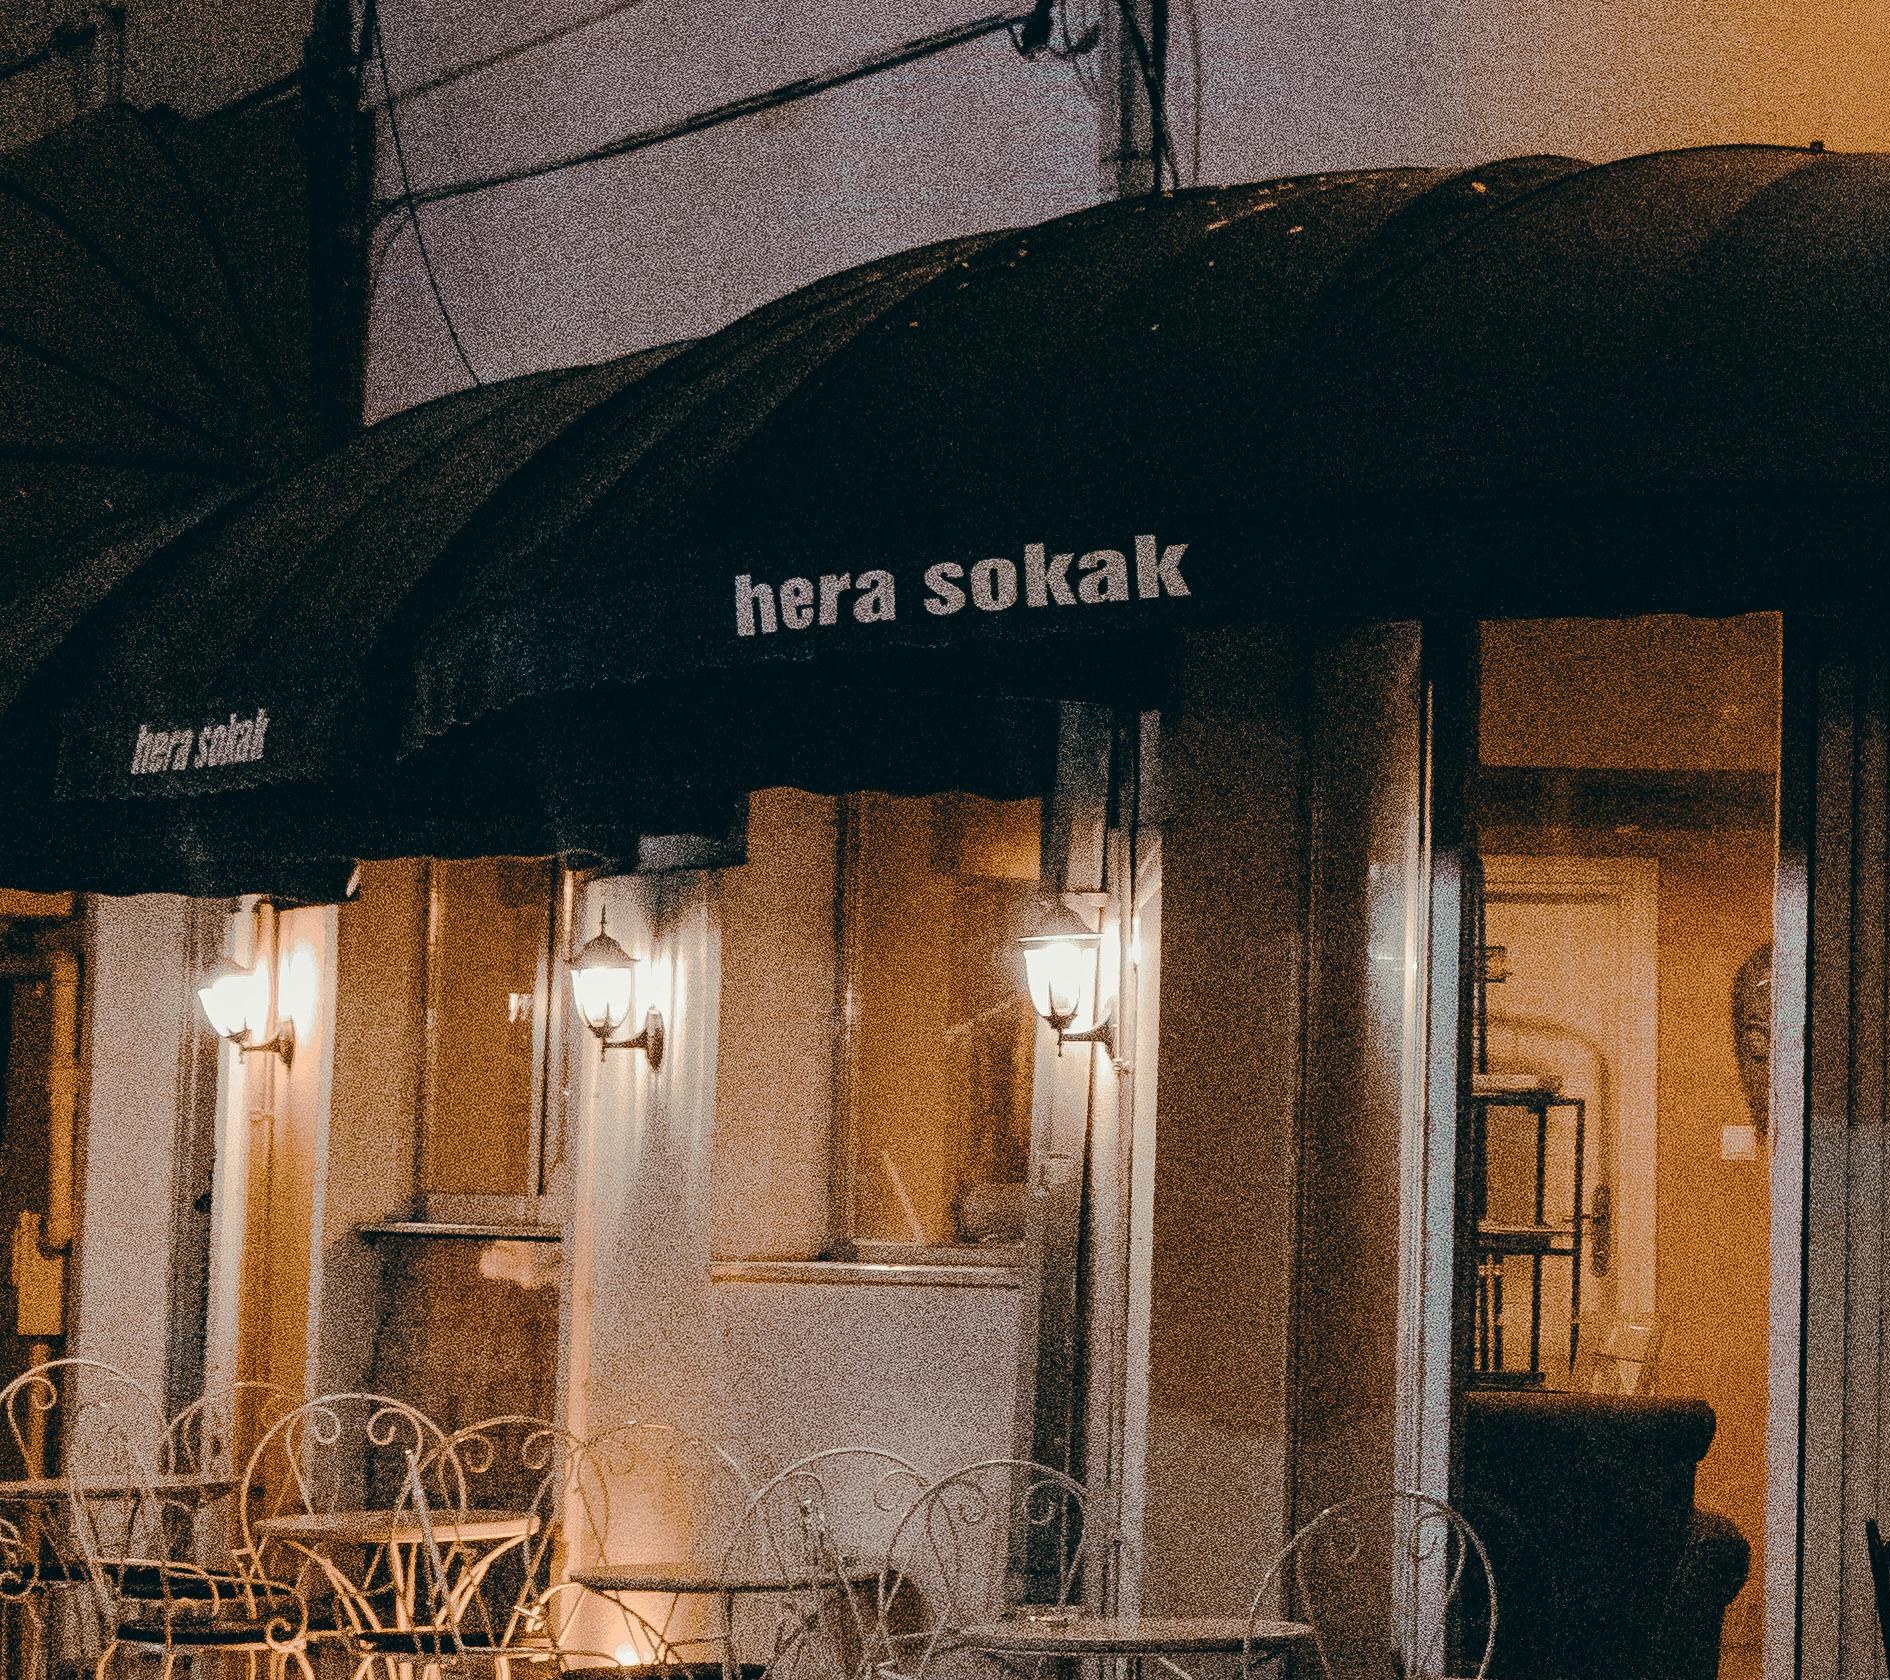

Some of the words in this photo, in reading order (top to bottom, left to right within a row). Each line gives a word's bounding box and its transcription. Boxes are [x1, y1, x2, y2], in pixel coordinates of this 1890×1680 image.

[734, 569, 897, 637] hera
[922, 533, 1191, 617] sokak
[130, 723, 195, 775] hera
[193, 707, 271, 770] sokak
